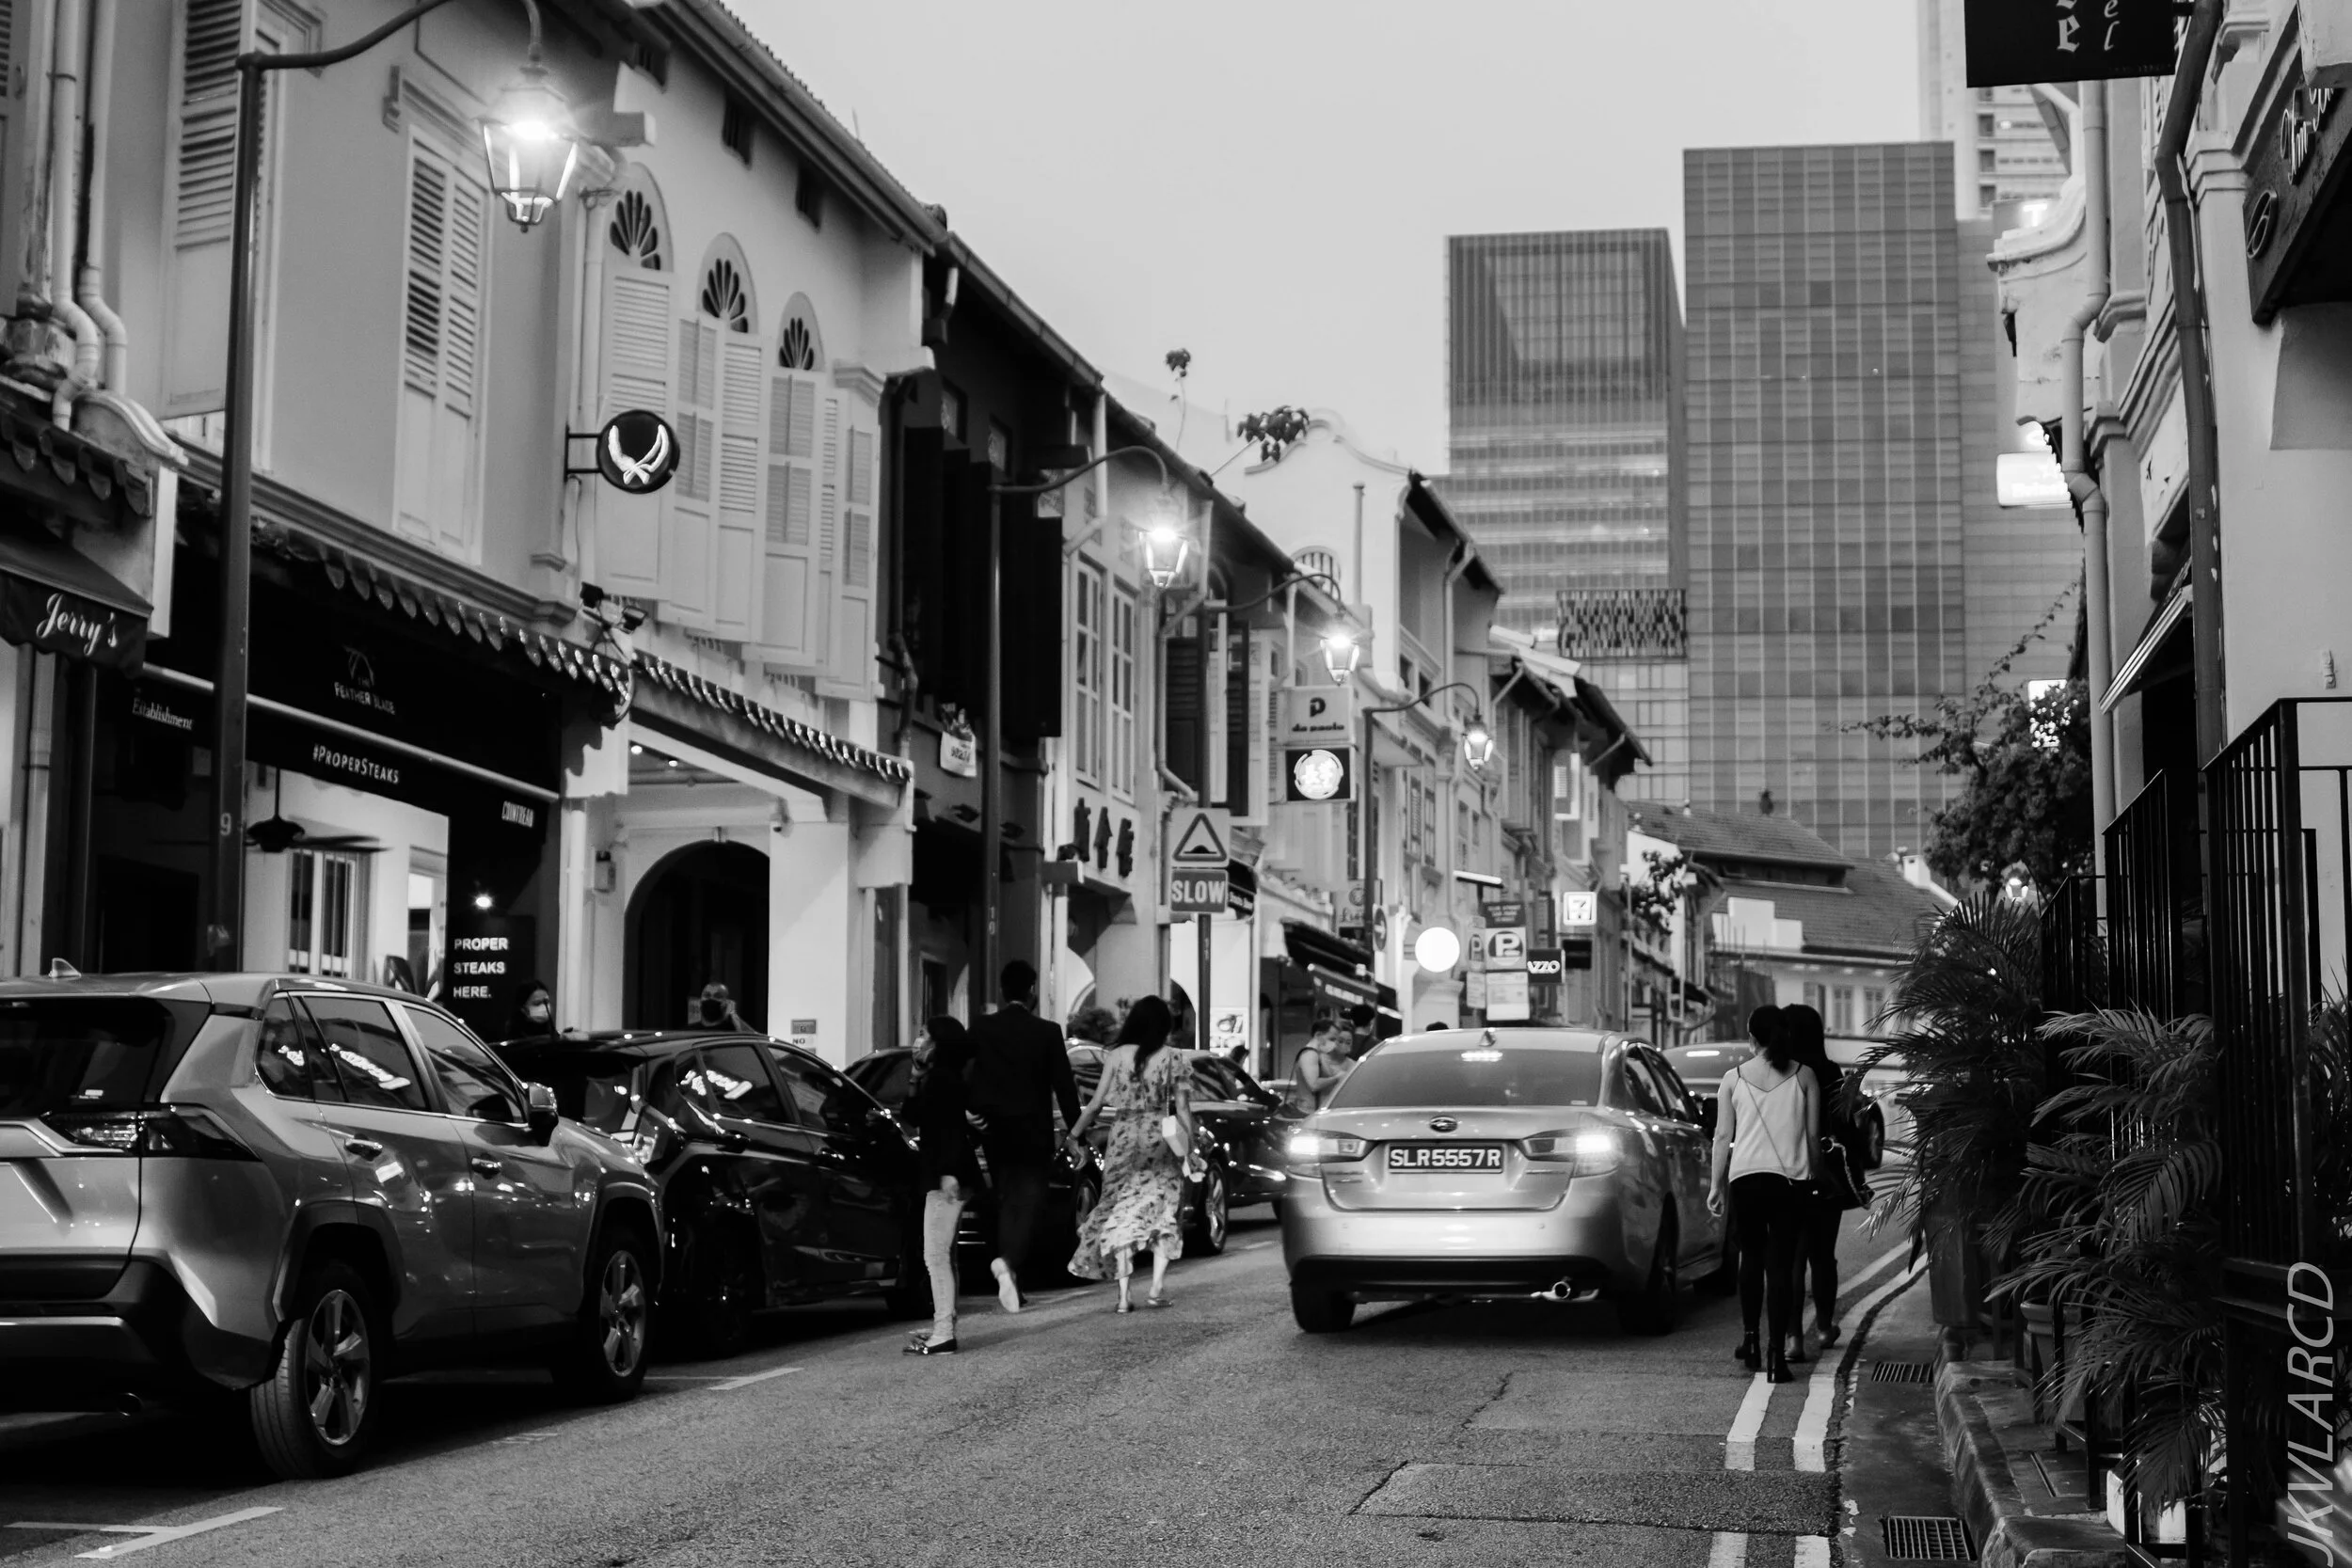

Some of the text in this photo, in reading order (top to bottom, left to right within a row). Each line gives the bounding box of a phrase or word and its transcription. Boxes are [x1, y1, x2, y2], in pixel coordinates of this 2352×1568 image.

[36, 593, 118, 657] Jerry's
[220, 813, 231, 836] 9
[1171, 879, 1226, 903] SLOW
[453, 937, 509, 951] PROPER
[453, 961, 505, 974] STEAKS
[453, 985, 491, 998] HERE.
[1391, 1148, 1502, 1167] SLR5557R
